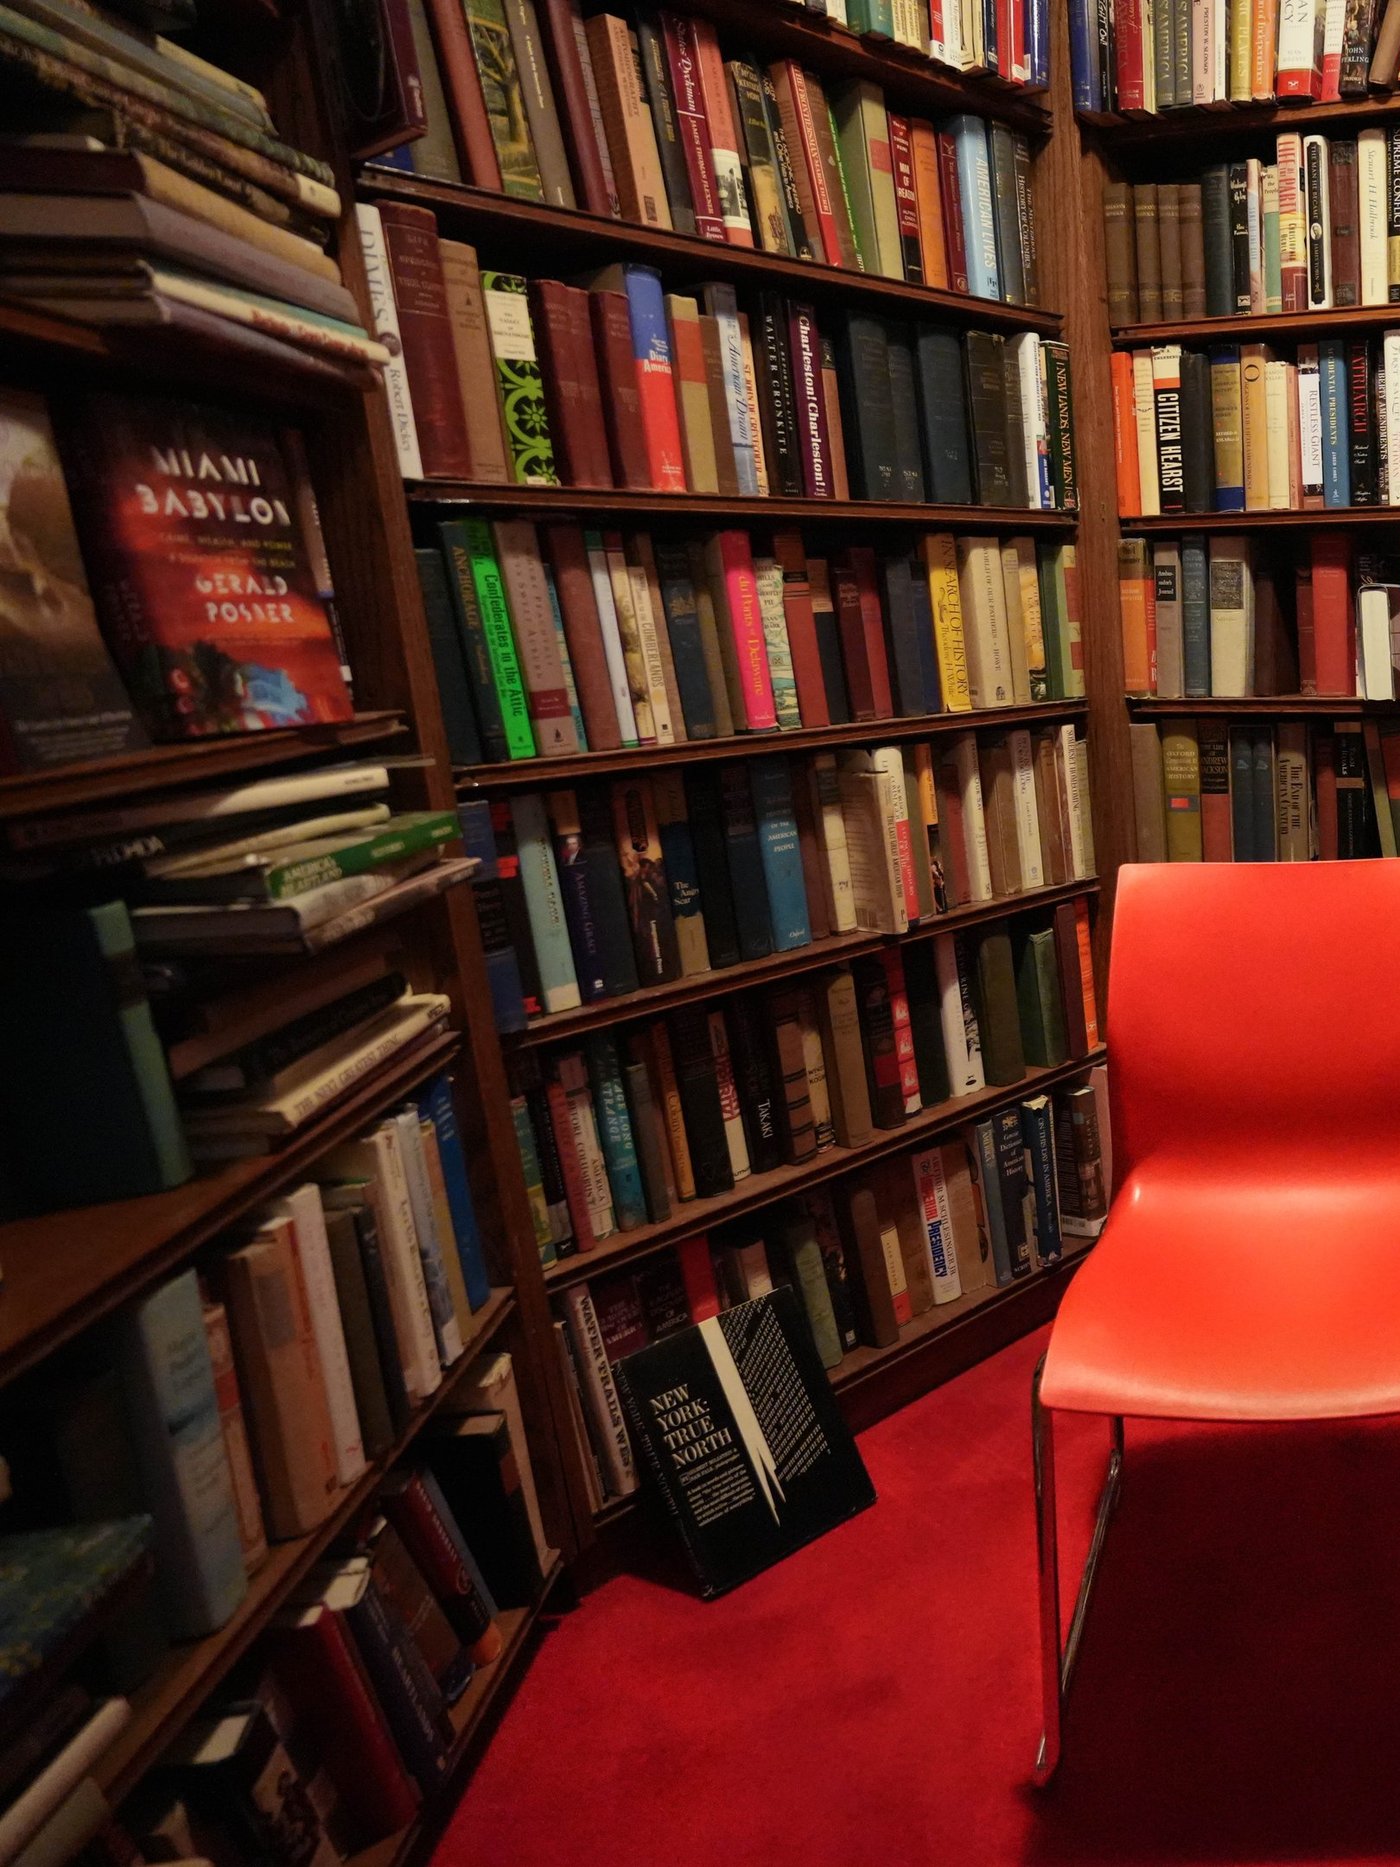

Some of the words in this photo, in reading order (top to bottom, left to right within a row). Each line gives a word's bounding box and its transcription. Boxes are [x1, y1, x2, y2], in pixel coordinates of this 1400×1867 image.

[678, 57, 696, 112] Dyckman
[690, 118, 699, 140] JAMES
[976, 159, 991, 222] AMERICAN
[980, 227, 996, 268] LIVES
[1022, 223, 1031, 269] COLUMBUS
[765, 315, 778, 371] WALTER
[773, 379, 787, 455] CRONKITE
[799, 315, 815, 400] Charleston!
[807, 402, 826, 487] Charleston!
[1157, 392, 1178, 442] CITIZEN
[1309, 390, 1318, 431] RESTLESS
[1328, 400, 1337, 445] PRESIDENTS
[152, 447, 260, 486] MIAMI
[1161, 445, 1183, 493] HEARST
[1311, 434, 1320, 467] GIANT
[134, 484, 291, 526] BABYLON
[195, 574, 288, 596] GERALD
[485, 575, 509, 649] Confederates
[506, 662, 516, 682] the
[640, 622, 664, 688] CUMBERLANDS
[953, 639, 968, 696] HISTORY
[508, 689, 523, 717] Attic
[758, 1099, 773, 1138] TAKAKI
[927, 1220, 947, 1278] PRESIDENCY
[579, 1295, 601, 1361] WATER
[650, 1383, 689, 1415] NEW
[657, 1399, 710, 1432] YORK:
[664, 1415, 715, 1450] TRUE
[672, 1428, 732, 1469] NORTH
